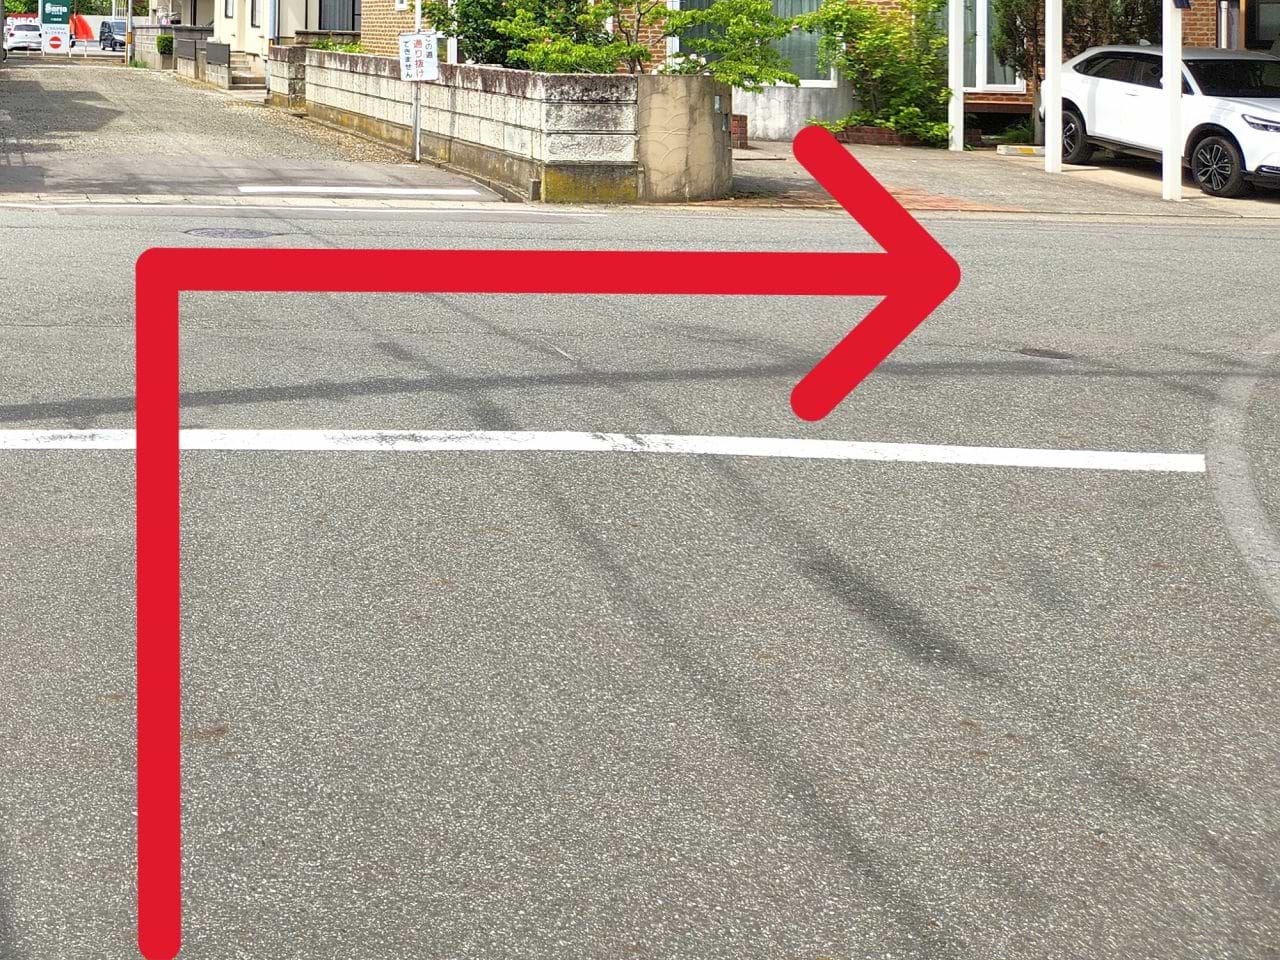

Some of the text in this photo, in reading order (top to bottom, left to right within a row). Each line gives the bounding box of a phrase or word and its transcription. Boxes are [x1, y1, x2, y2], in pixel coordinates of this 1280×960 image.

[403, 40, 413, 79] できません
[414, 39, 424, 78] 通り抜け
[425, 35, 433, 59] この道
